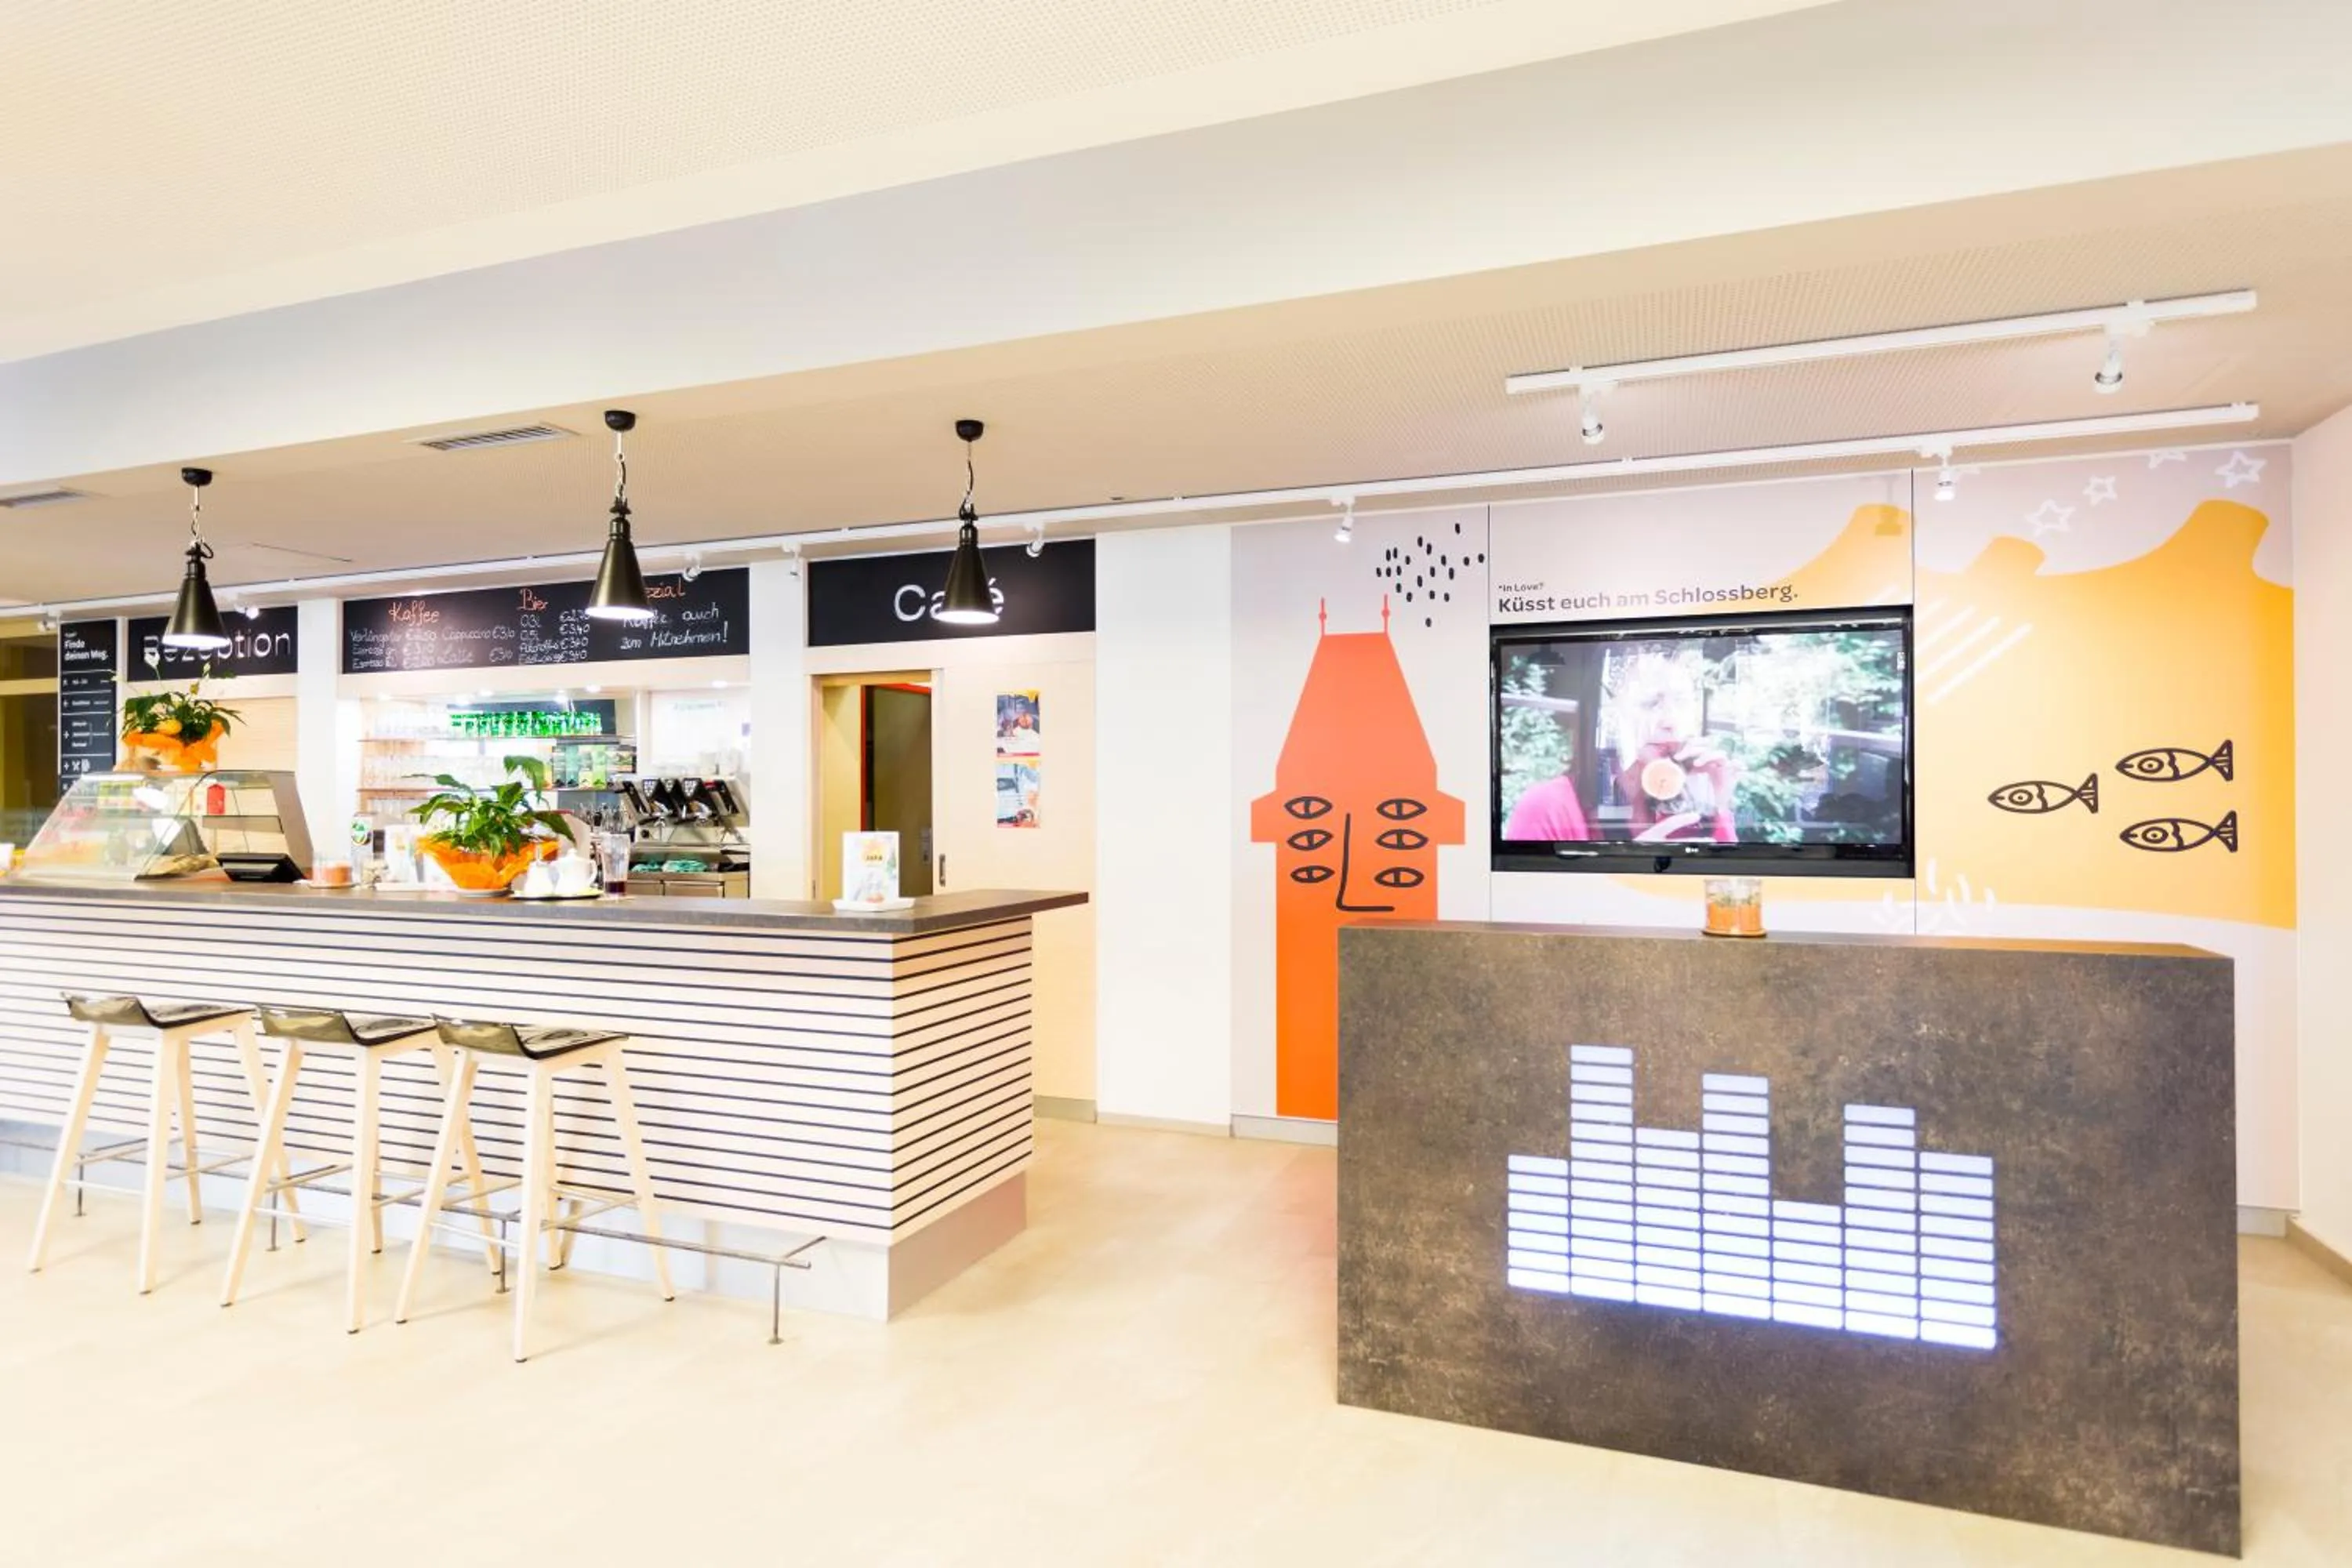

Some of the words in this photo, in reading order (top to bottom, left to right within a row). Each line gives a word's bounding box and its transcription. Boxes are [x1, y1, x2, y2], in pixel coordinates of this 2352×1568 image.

[517, 588, 549, 611] Bier
[894, 577, 1004, 622] Caé
[1499, 597, 1555, 612] Küsst
[1561, 593, 1610, 609] euch
[1617, 593, 1650, 608] am
[1655, 584, 1798, 604] Schlossberg.
[1514, 583, 1544, 592] Love?
[388, 600, 440, 626] Kaffee
[681, 602, 719, 621] auch
